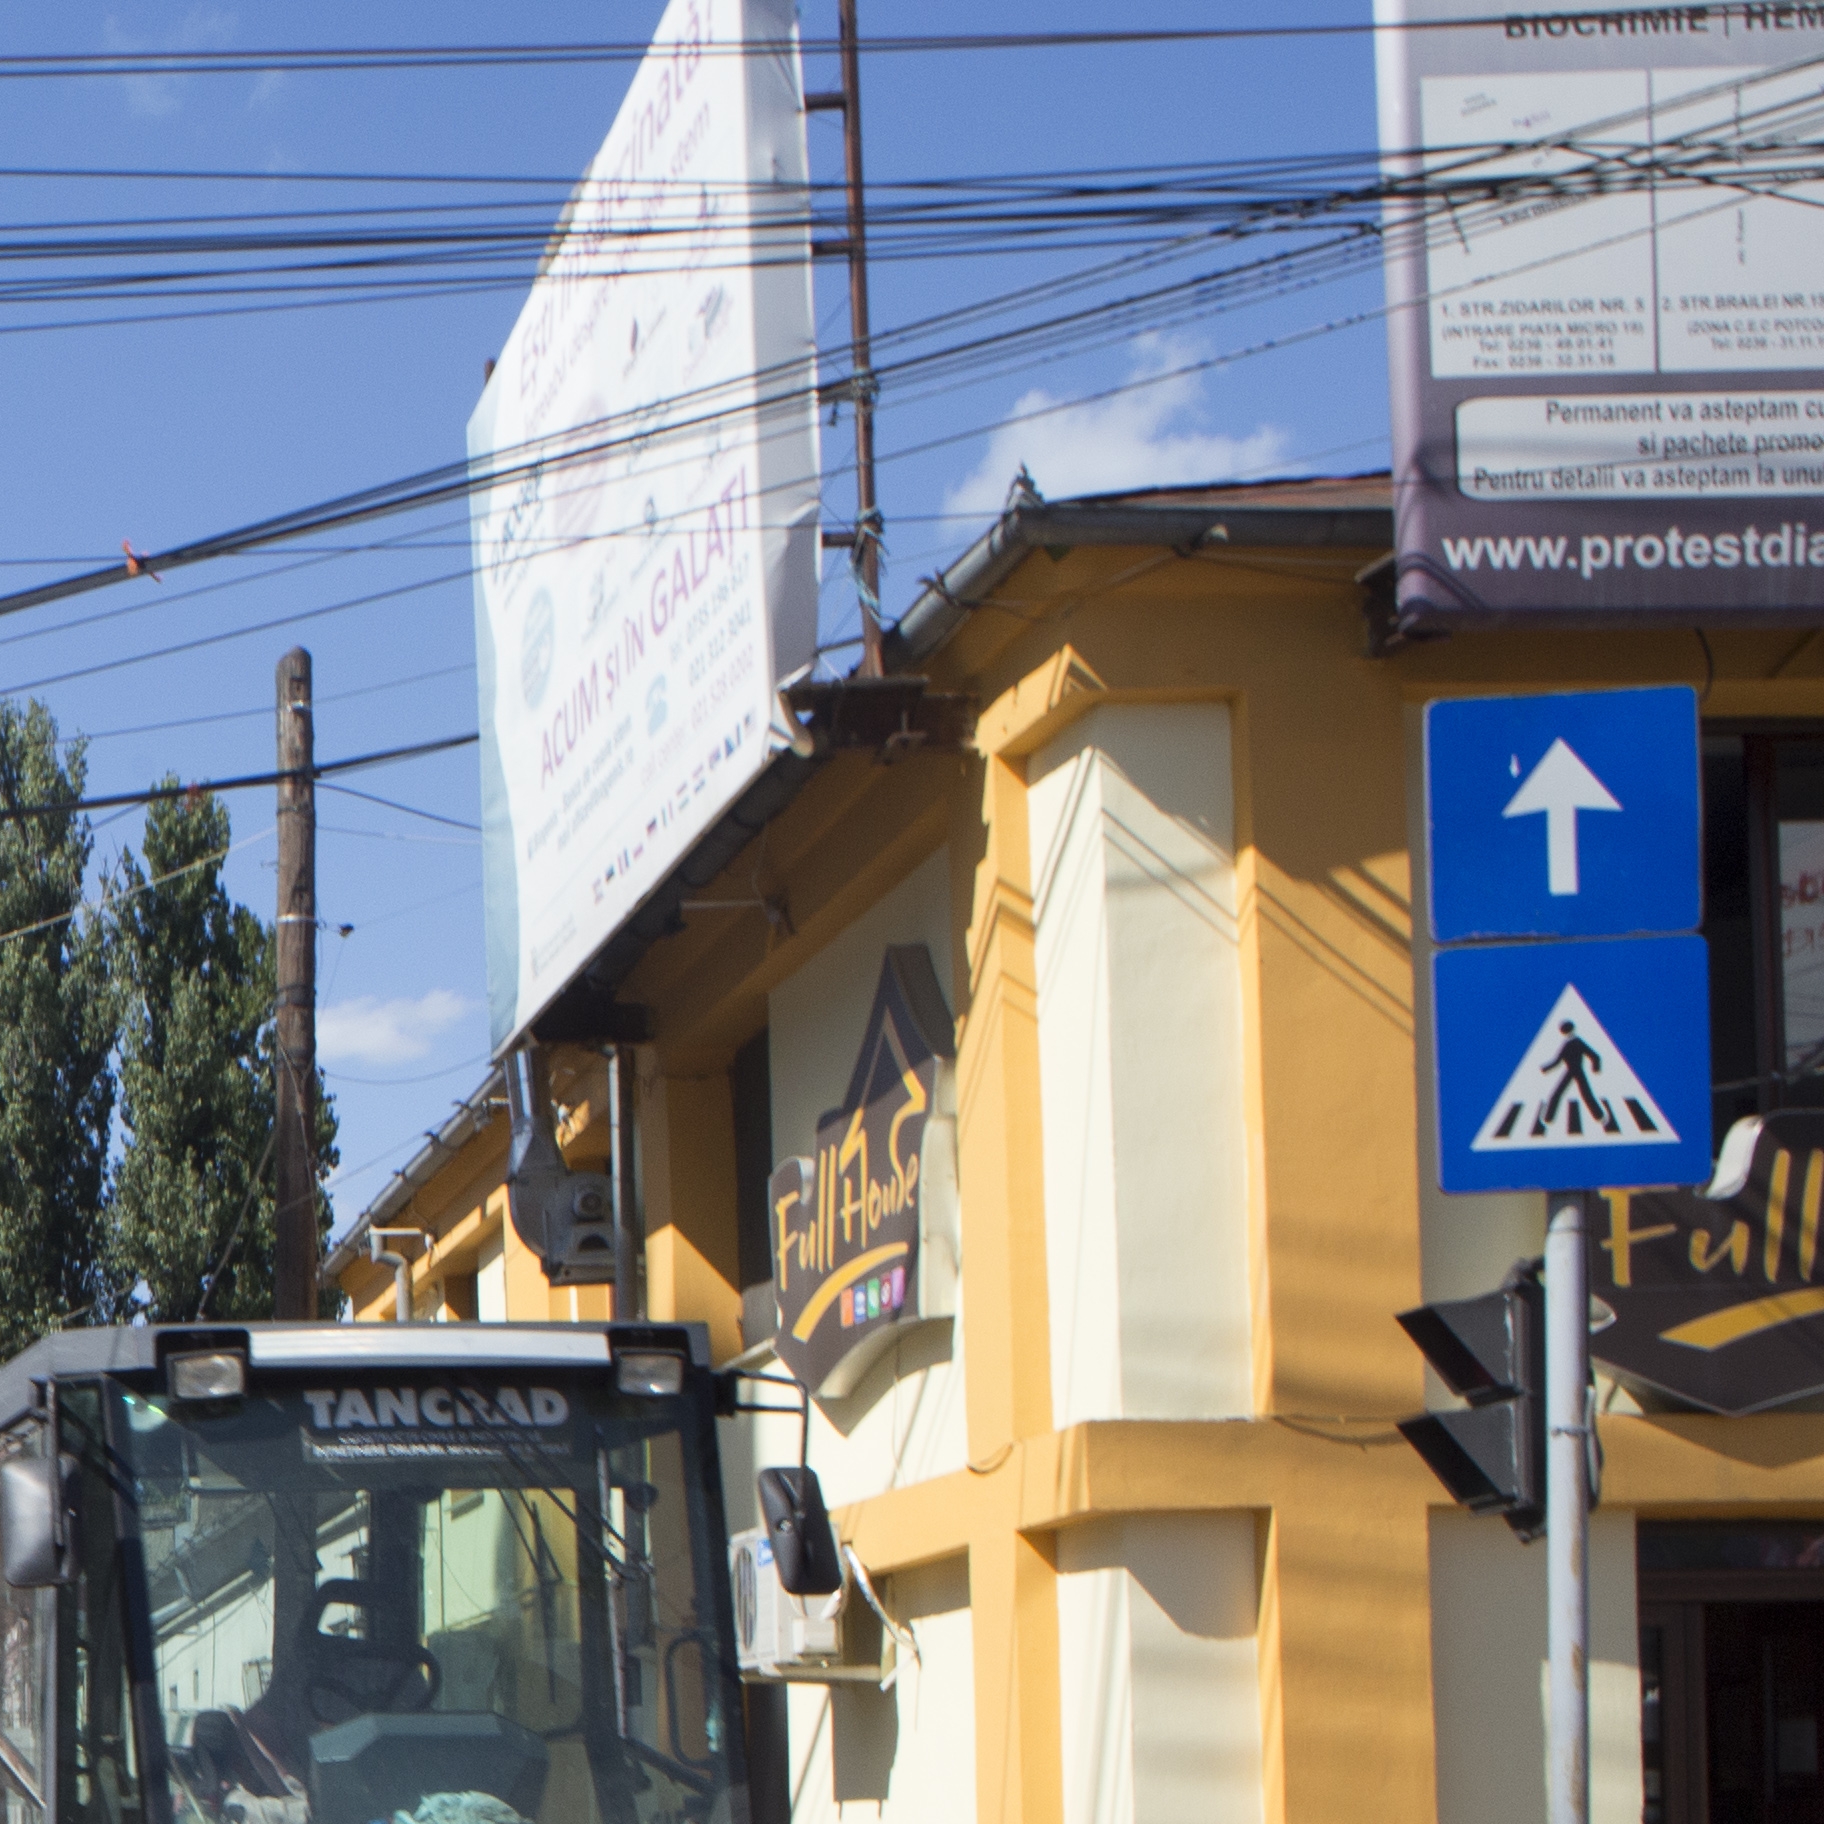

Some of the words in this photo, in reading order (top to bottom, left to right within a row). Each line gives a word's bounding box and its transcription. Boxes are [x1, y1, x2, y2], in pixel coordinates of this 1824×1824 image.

[1504, 6, 1709, 39] BIOCHIMIE
[1545, 401, 1663, 425] Permanent
[1668, 404, 1693, 421] va
[1700, 399, 1799, 428] asteptam
[1637, 431, 1657, 455] si
[1662, 431, 1749, 461] pachete
[1473, 466, 1545, 491] Pentru
[1551, 463, 1615, 490] detalii
[1621, 468, 1646, 488] va
[1652, 463, 1751, 493] asteptam
[1757, 462, 1776, 485] la
[1782, 463, 1824, 486] unu
[541, 656, 600, 791] ACUM
[774, 1142, 837, 1293] Full
[1599, 1148, 1824, 1288] Full
[302, 1386, 570, 1430] TANCRAD
